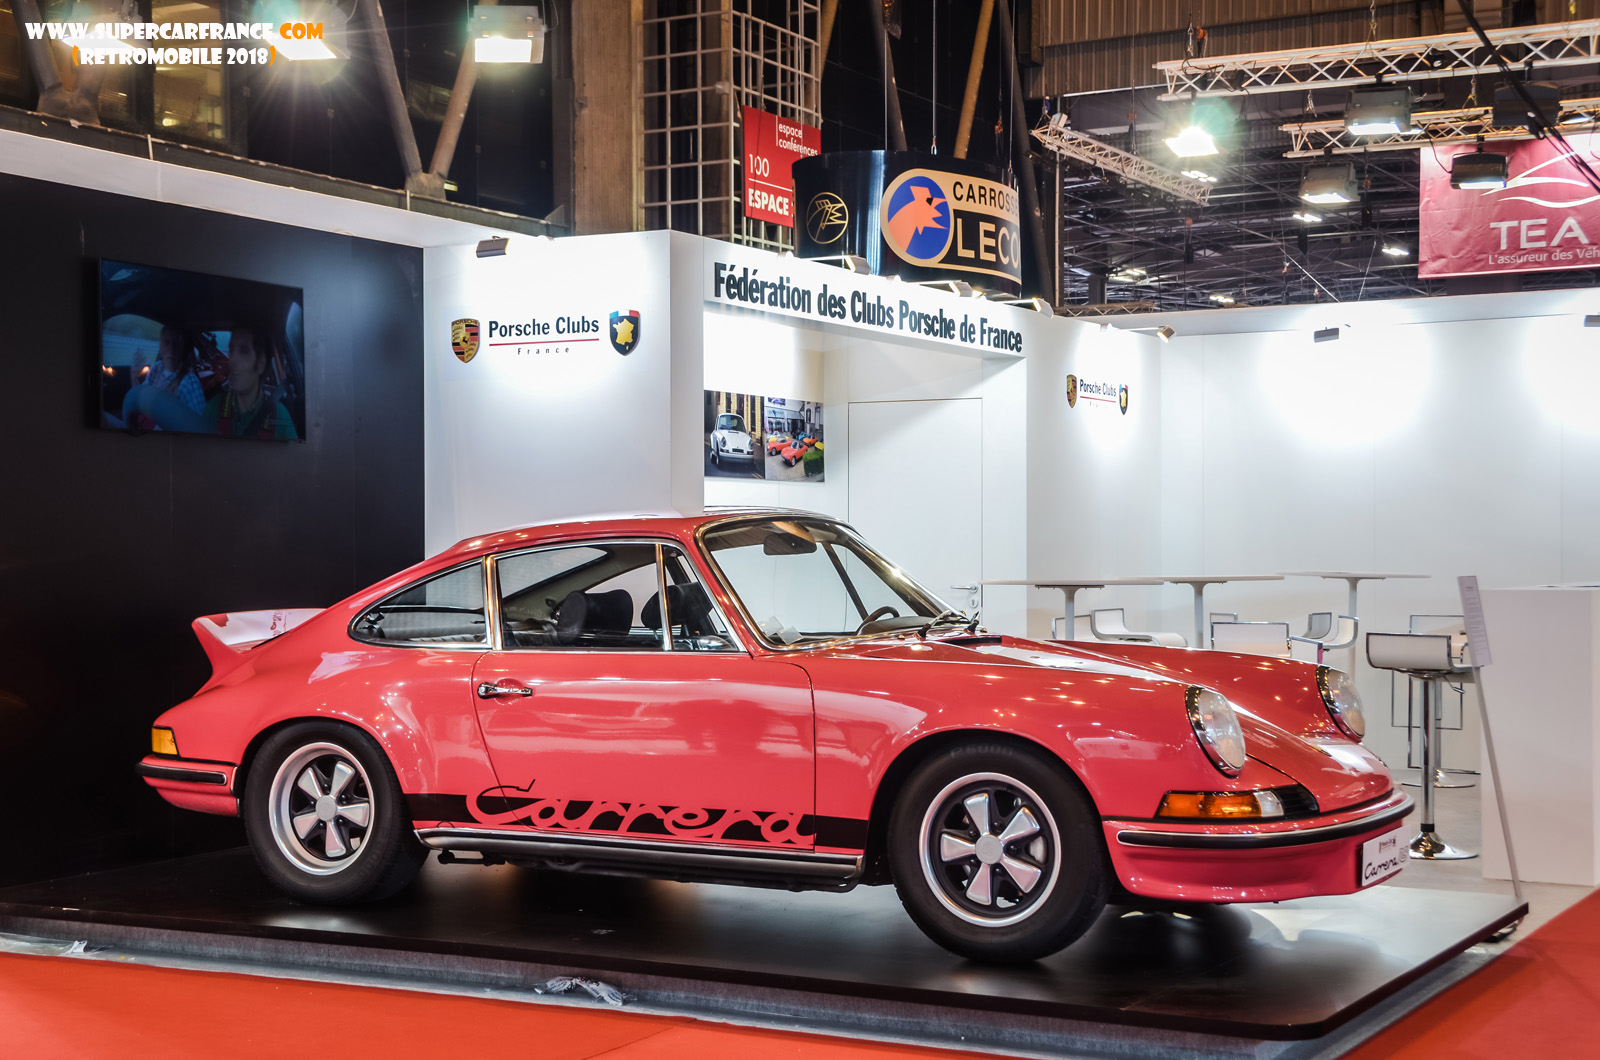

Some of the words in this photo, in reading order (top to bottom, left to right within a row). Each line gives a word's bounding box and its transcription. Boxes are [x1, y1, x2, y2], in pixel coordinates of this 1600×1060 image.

[778, 123, 803, 138] espace
[778, 137, 818, 156] conférences
[748, 153, 770, 178] 100
[748, 188, 790, 216] ESPACE
[956, 217, 1019, 269] LECO
[1489, 216, 1589, 250] TEA
[1488, 252, 1548, 265] L'assureur
[1551, 249, 1574, 261] des
[714, 261, 811, 314] Fédération
[817, 284, 846, 319] des
[850, 290, 894, 328] Clubs
[899, 300, 955, 340] Porsche
[959, 314, 976, 344] de
[980, 317, 1022, 353] France
[488, 318, 550, 338] Porsche
[555, 315, 600, 335] Clubs
[517, 346, 570, 356] France
[1079, 378, 1101, 395] Porsche
[1102, 382, 1117, 397] Clubs
[465, 778, 817, 845] Carrera
